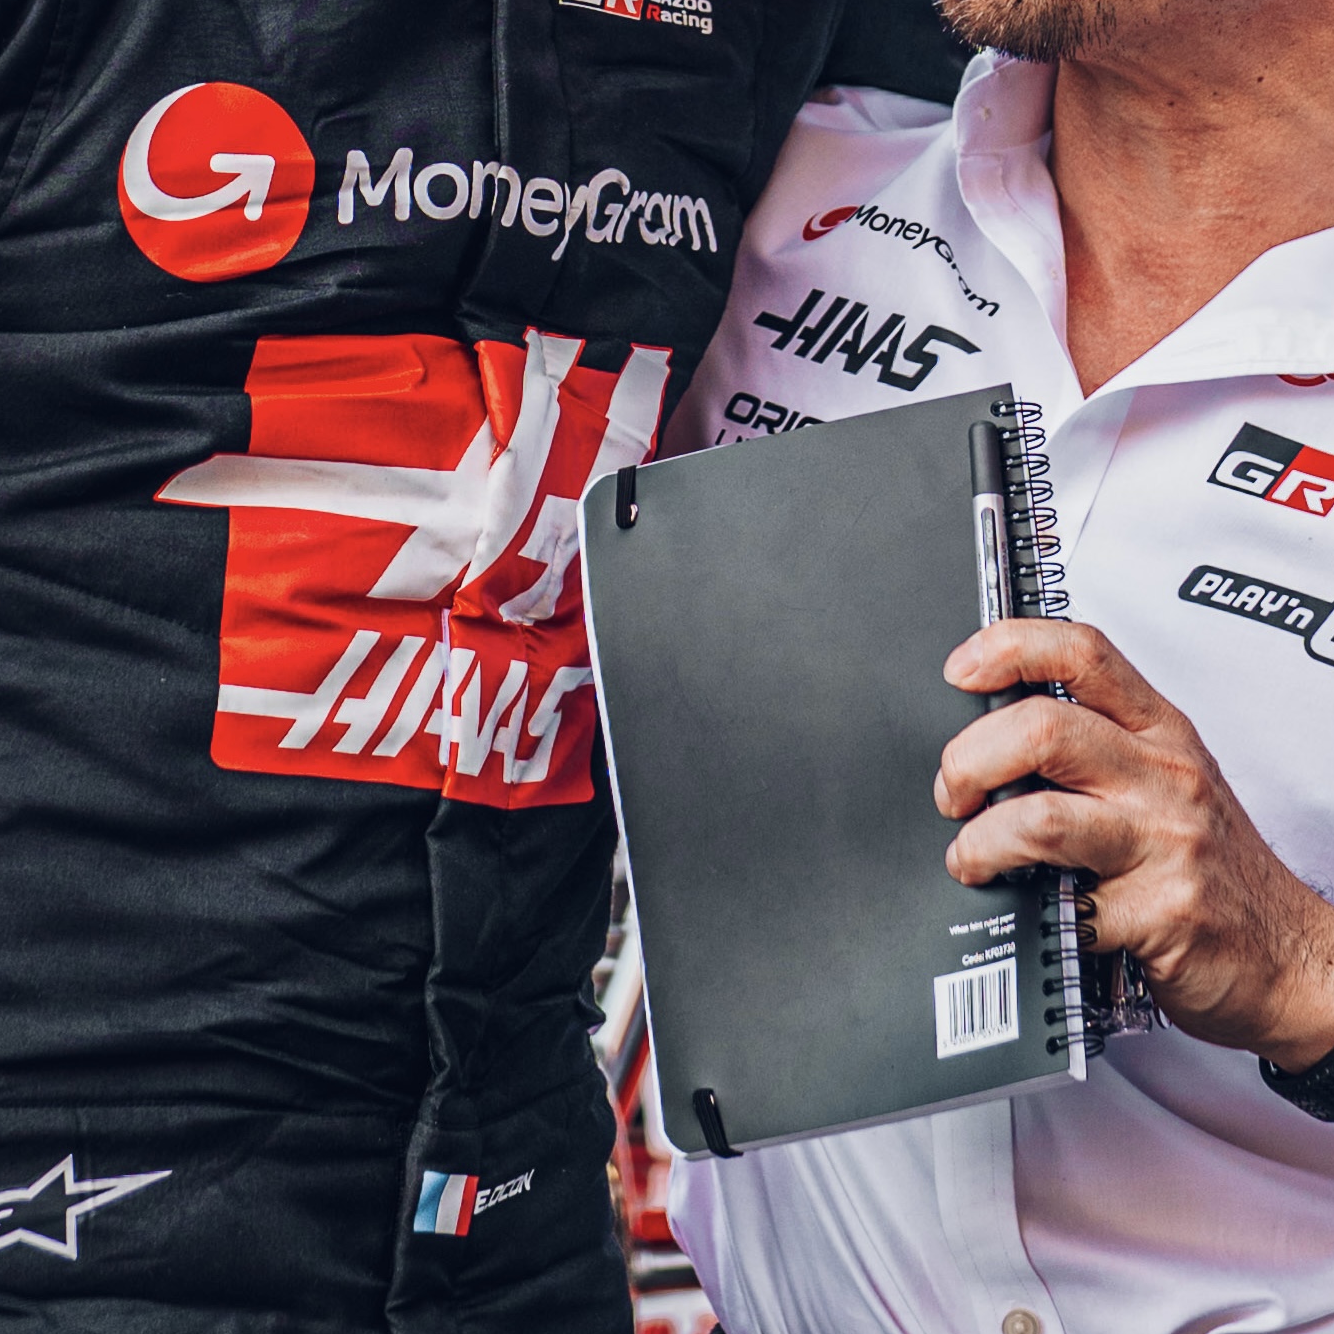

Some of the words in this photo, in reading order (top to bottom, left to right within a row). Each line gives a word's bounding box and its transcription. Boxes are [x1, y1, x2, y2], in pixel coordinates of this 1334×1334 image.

[646, 4, 713, 35] Racing
[337, 147, 718, 261] MoneyGram
[845, 204, 1000, 317] MoneyGram
[753, 288, 982, 392] HAAS
[218, 630, 593, 783] HAAS
